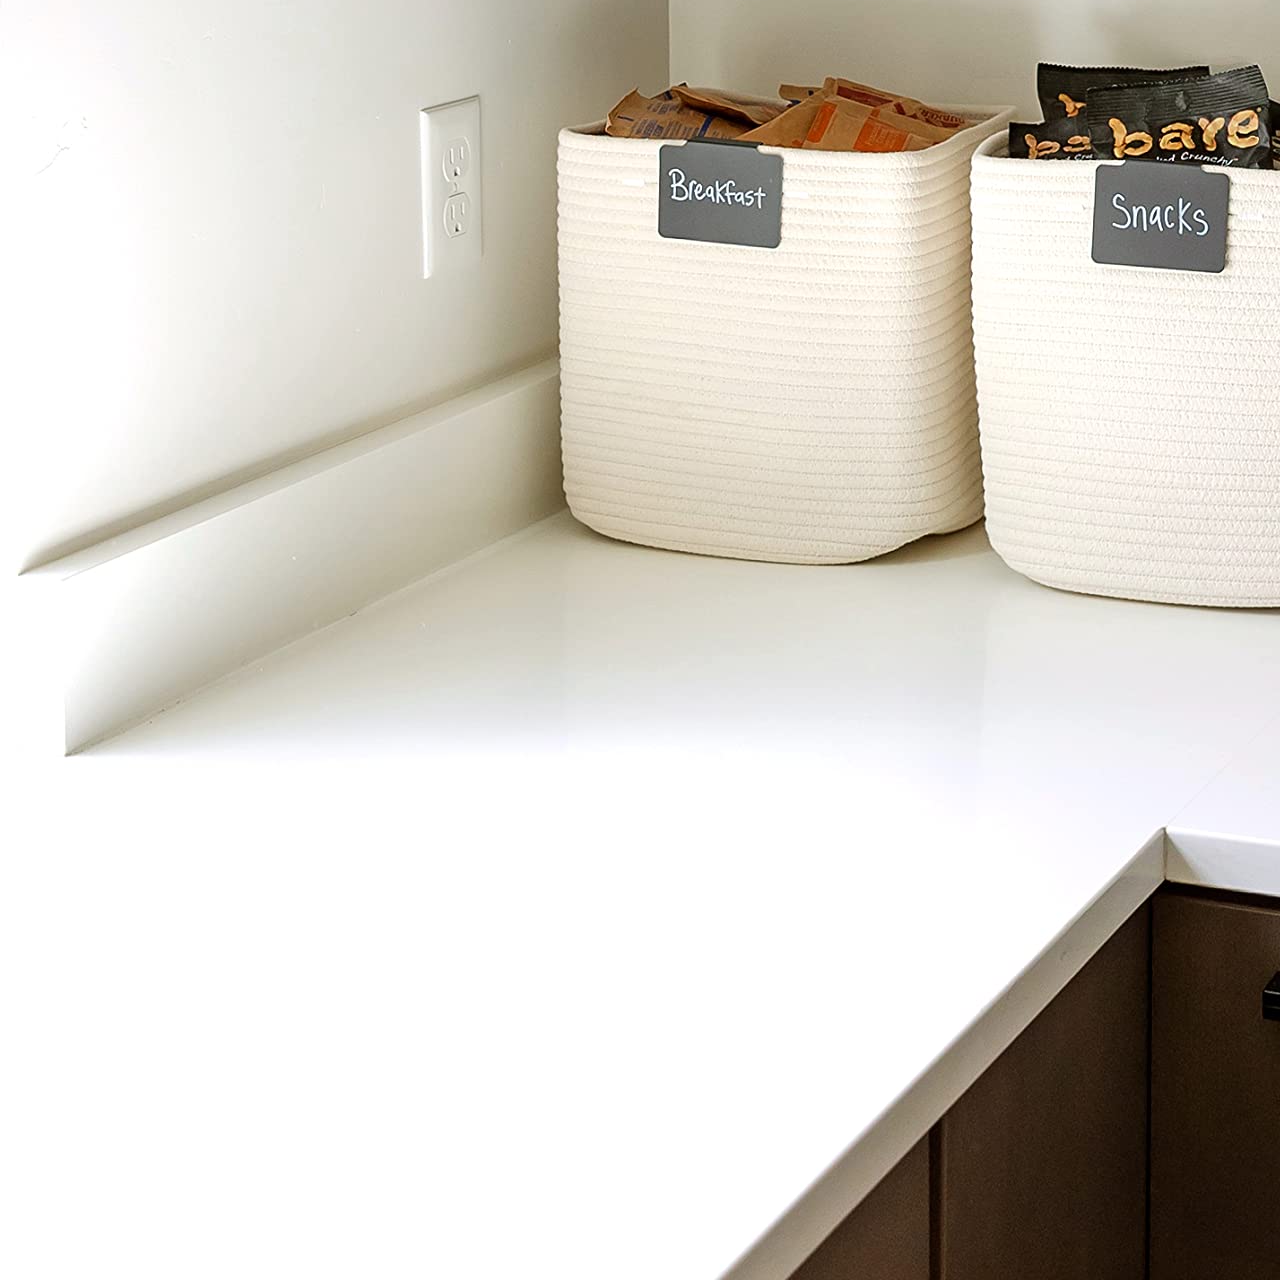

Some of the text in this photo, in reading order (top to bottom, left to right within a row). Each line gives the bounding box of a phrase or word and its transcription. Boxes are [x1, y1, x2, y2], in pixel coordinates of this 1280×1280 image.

[1024, 133, 1092, 159] ba
[1108, 109, 1260, 158] bare
[1180, 151, 1235, 166] Crunchy
[667, 167, 767, 210] Breakfast
[1112, 192, 1210, 236] Snacks
